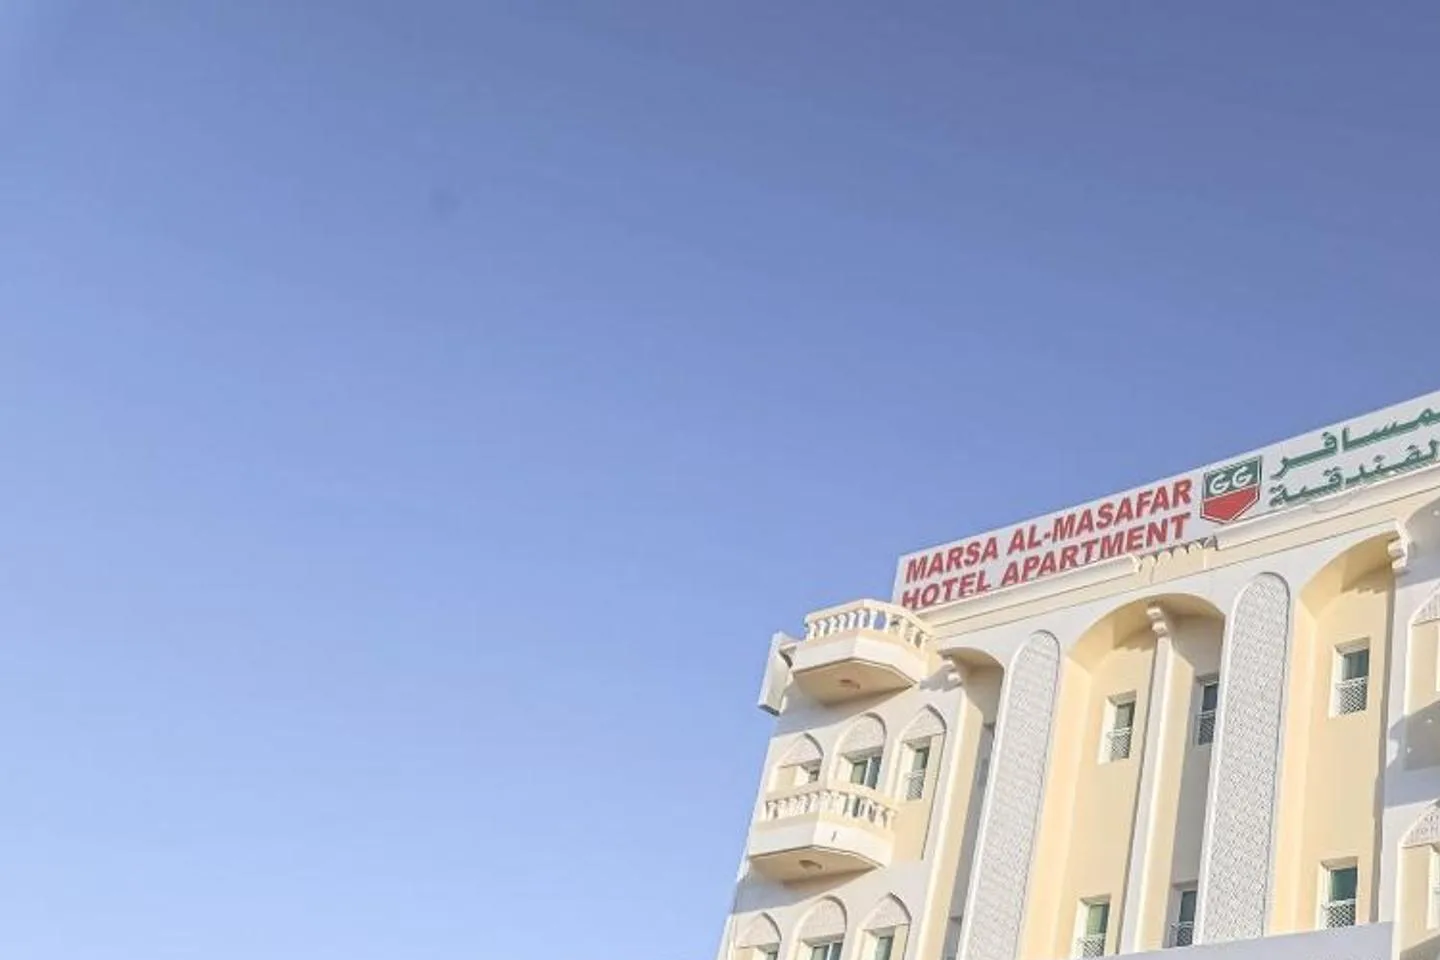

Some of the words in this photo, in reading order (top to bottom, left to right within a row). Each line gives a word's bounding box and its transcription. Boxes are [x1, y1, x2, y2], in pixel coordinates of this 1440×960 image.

[901, 569, 992, 611] HOTEL
[1001, 512, 1191, 588] APARTMENT
[905, 537, 998, 584] MARSA
[1007, 478, 1193, 556] AL-MASAFAR
